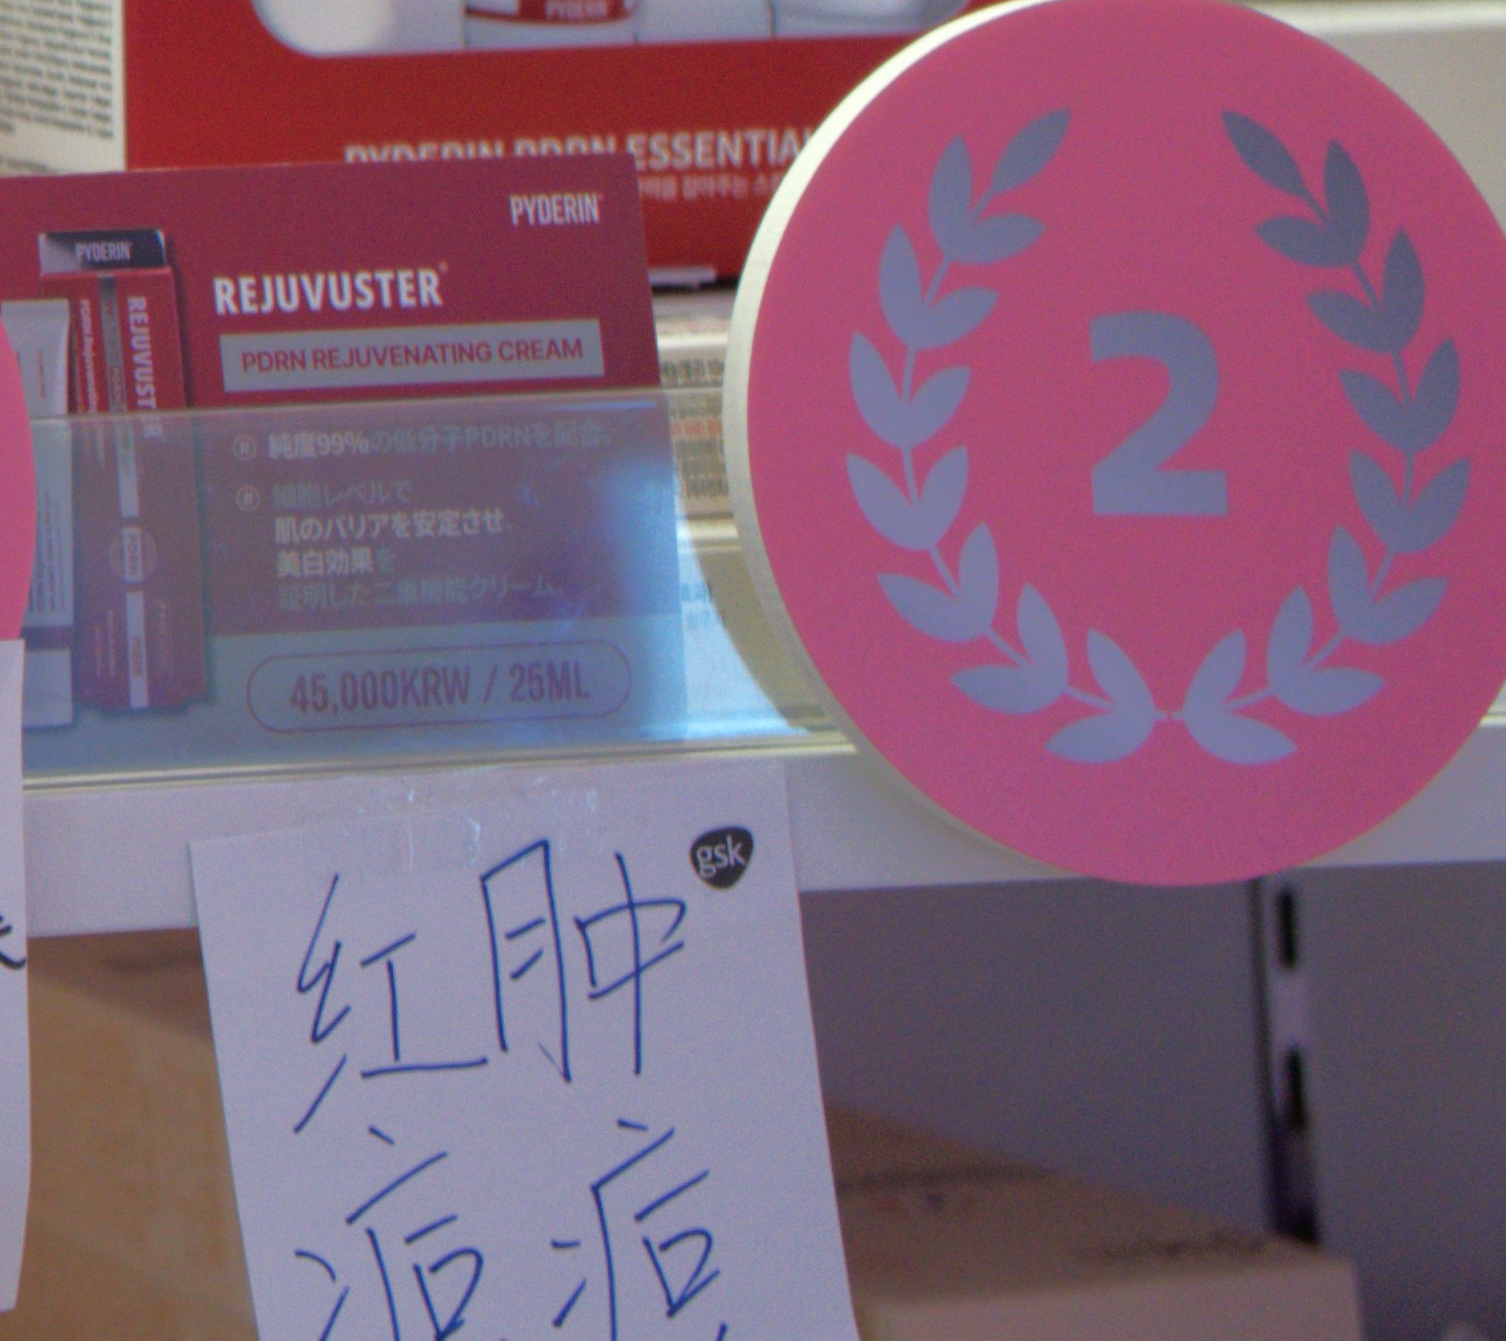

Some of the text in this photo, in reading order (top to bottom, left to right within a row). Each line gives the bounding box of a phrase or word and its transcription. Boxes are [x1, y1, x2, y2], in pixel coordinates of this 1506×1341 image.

[625, 124, 812, 173] ESSENTIA
[508, 193, 602, 227] PYDERIN
[74, 241, 131, 263] PYDERIN
[212, 268, 444, 318] REJUVUSTER
[240, 335, 583, 375] PDRN REJUVENATING CREAM
[1087, 309, 1230, 518] 2
[289, 661, 591, 716] 45,000KRW / 25ML
[694, 833, 748, 883] gsk
[293, 838, 689, 1135] 红肿
